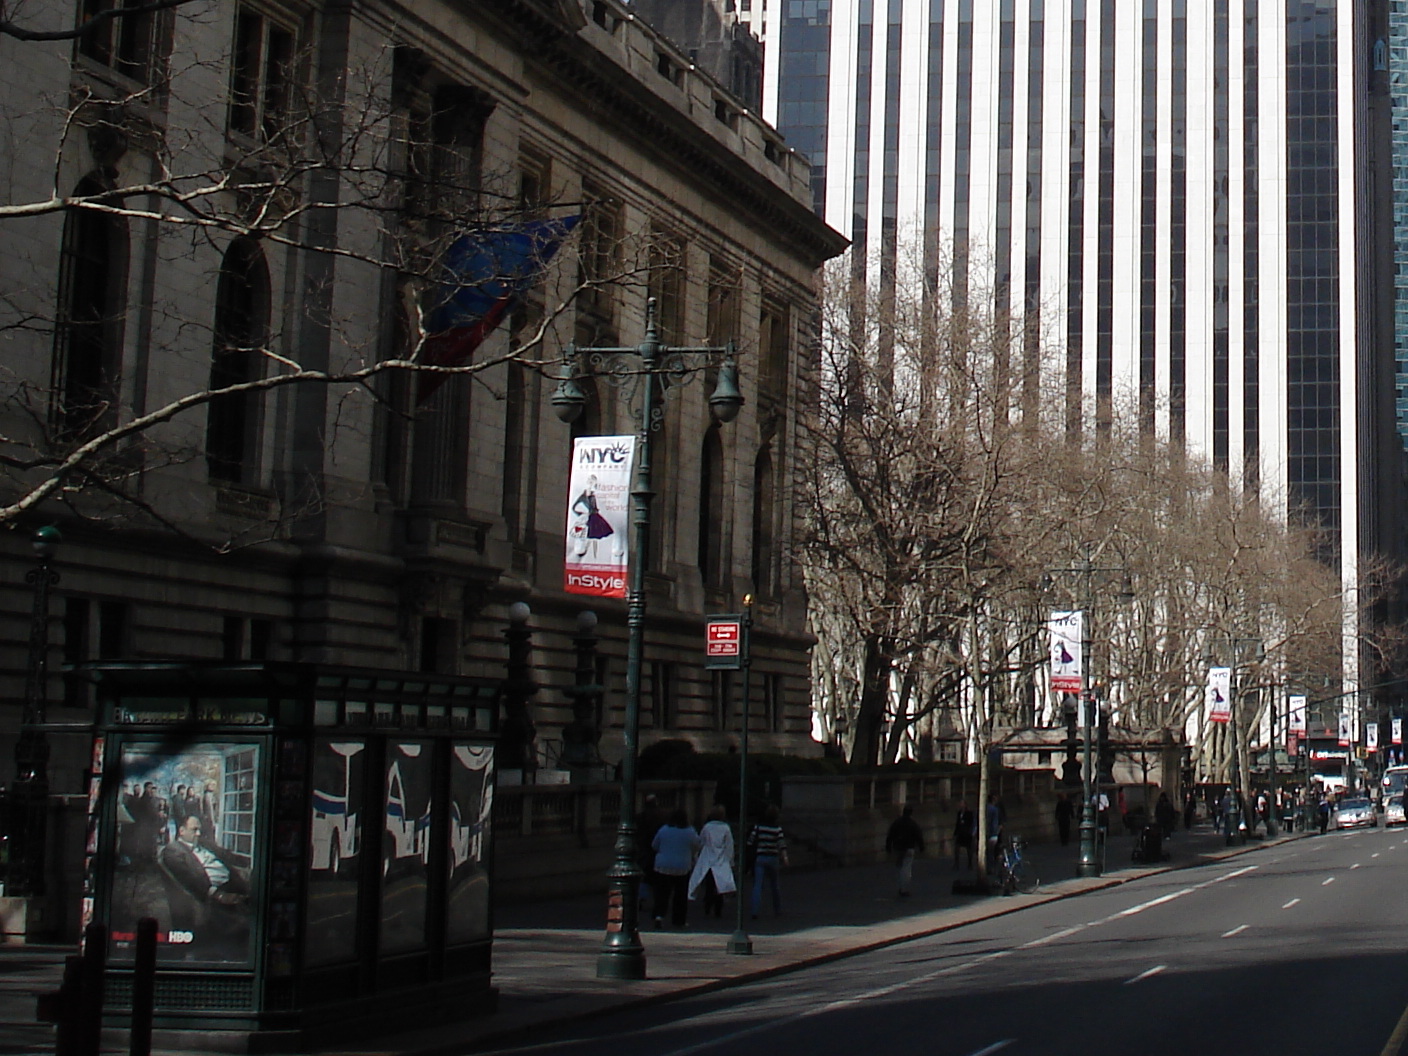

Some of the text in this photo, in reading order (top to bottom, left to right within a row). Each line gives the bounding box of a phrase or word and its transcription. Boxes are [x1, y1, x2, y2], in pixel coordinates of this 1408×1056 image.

[580, 444, 628, 463] NYC
[568, 573, 625, 590] InStyle
[168, 930, 194, 943] HBO
